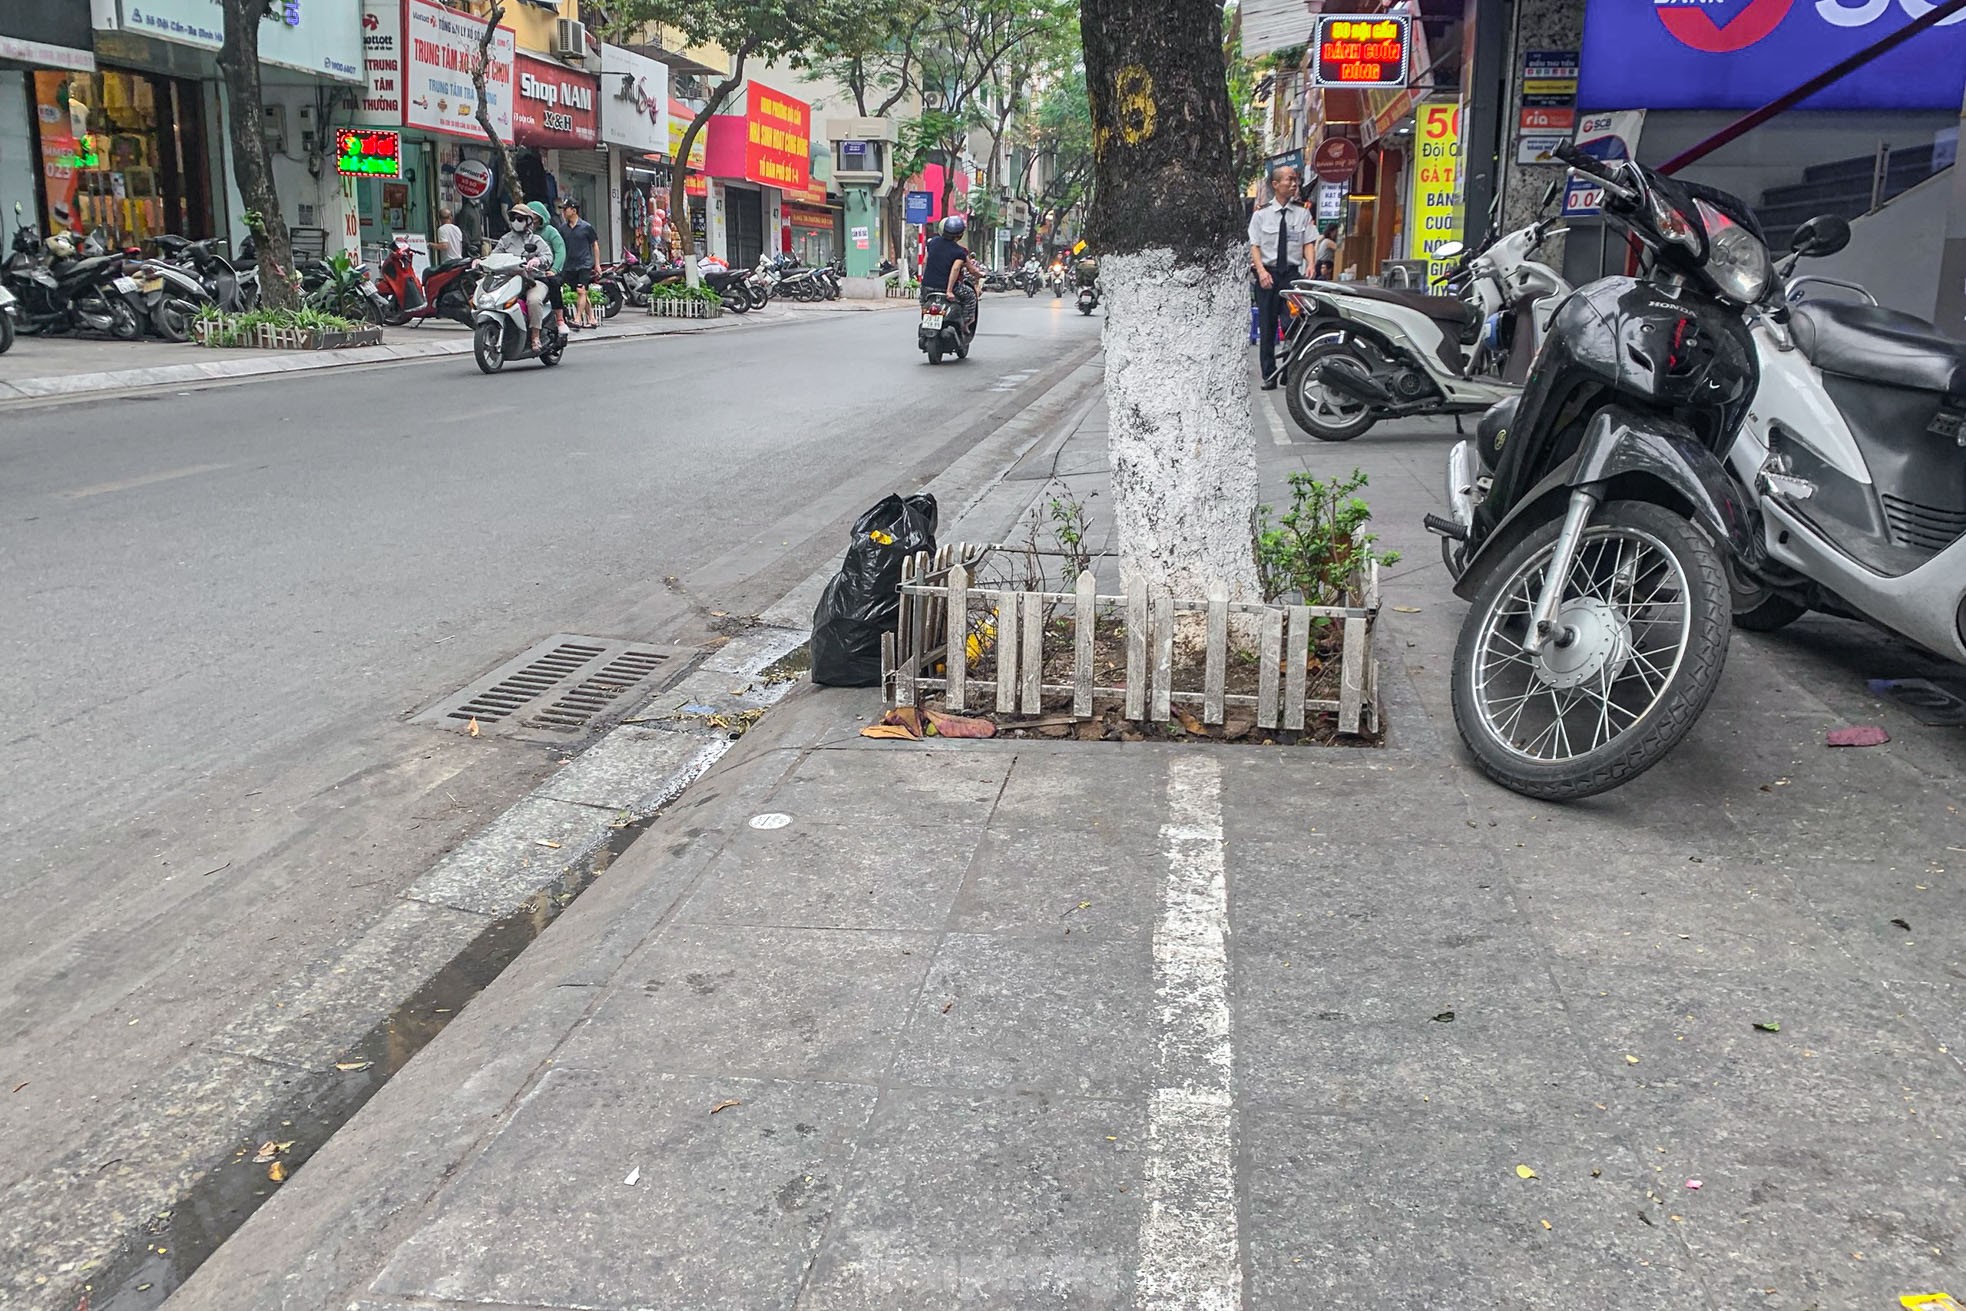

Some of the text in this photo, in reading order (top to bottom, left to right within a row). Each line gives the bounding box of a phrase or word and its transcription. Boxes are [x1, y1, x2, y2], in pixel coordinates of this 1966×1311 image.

[438, 15, 451, 33] TỔNG
[414, 38, 440, 66] TRUNG
[441, 42, 458, 72] TÂM
[1323, 38, 1401, 60] BÁNH CUỐN
[1341, 60, 1381, 80] NÓNG
[374, 77, 394, 91] TÂM
[428, 78, 449, 95] TRUNG
[450, 81, 463, 98] TÂM
[521, 72, 557, 107] Shop
[561, 82, 592, 111] NAM
[362, 95, 398, 111] THƯỞNG
[1526, 110, 1548, 125] ria
[1594, 118, 1612, 128] SCB
[760, 124, 773, 149] SINH
[1422, 142, 1444, 161] Đội
[1420, 164, 1439, 183] GÀ
[611, 188, 620, 200] 51
[715, 199, 722, 212] 47
[773, 207, 779, 219] 47
[1426, 214, 1453, 231] CUỐ
[1648, 300, 1698, 319] HONDA
